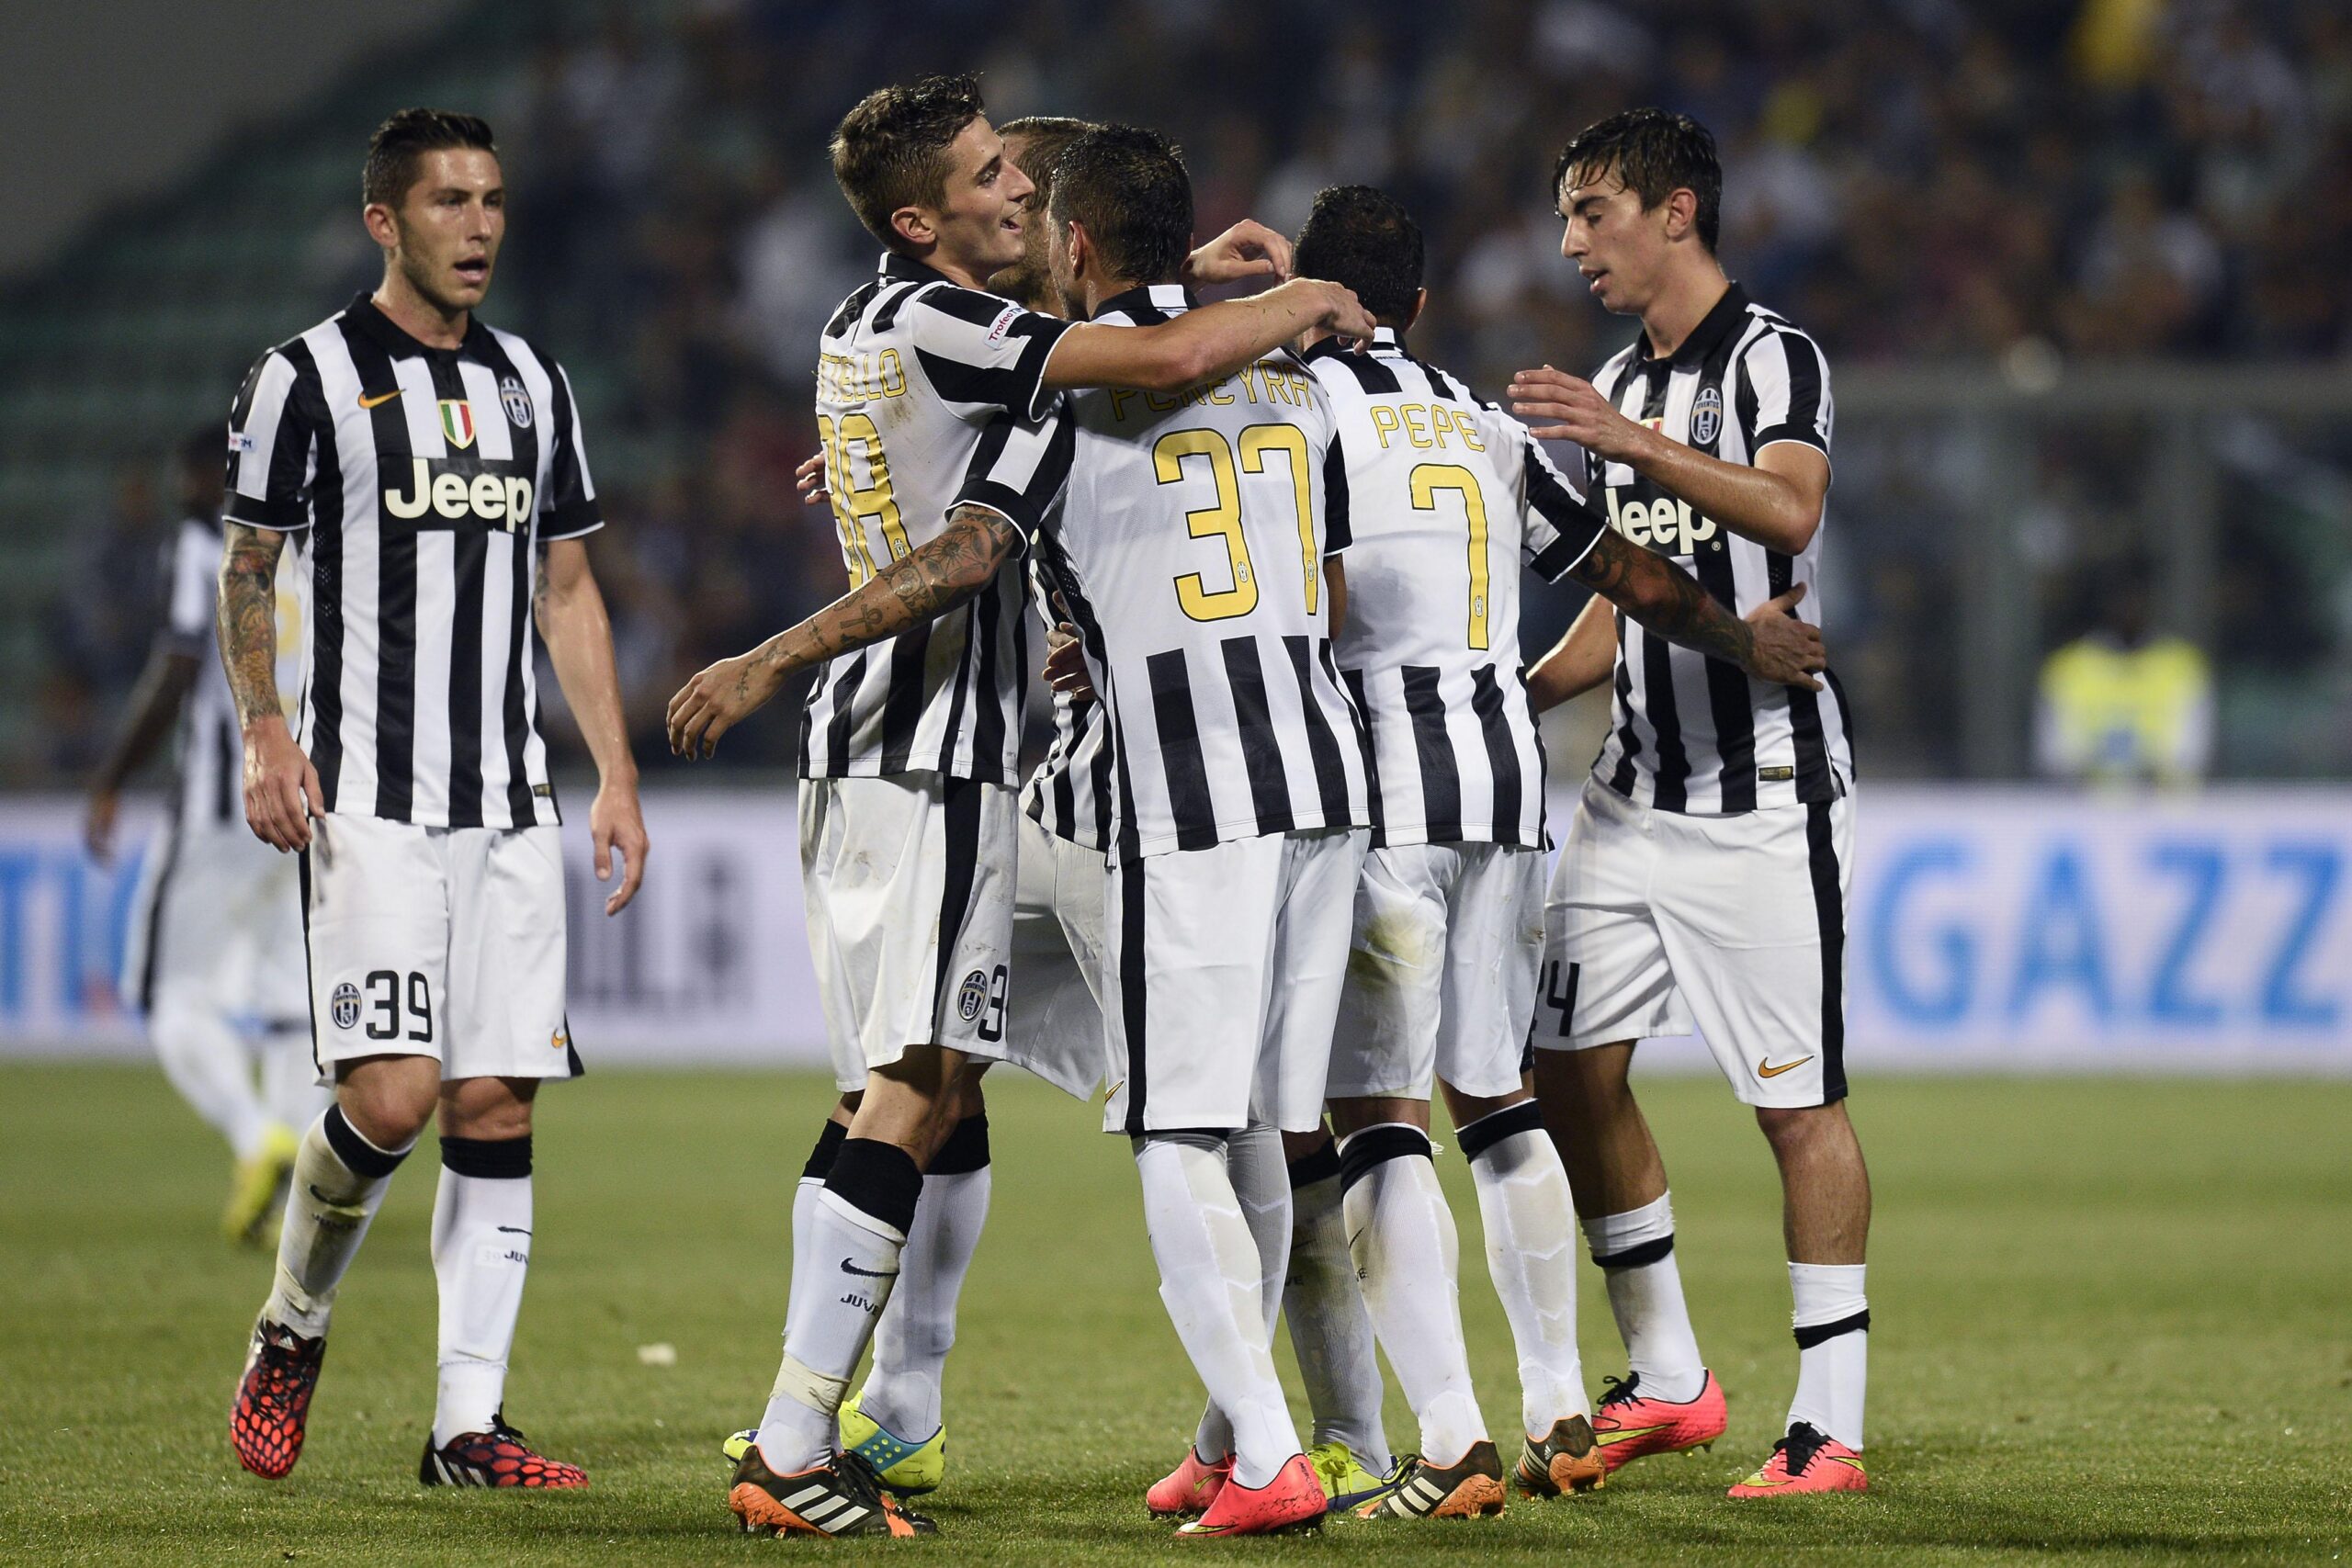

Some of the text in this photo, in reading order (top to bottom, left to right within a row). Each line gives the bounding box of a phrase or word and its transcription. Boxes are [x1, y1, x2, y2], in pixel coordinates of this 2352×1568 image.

[1370, 402, 1486, 453] PEPE
[384, 457, 534, 535] Jeep
[1151, 423, 1318, 623] 37
[1408, 463, 1490, 651] 7
[366, 969, 433, 1043] 39
[1530, 959, 1581, 1038] 4
